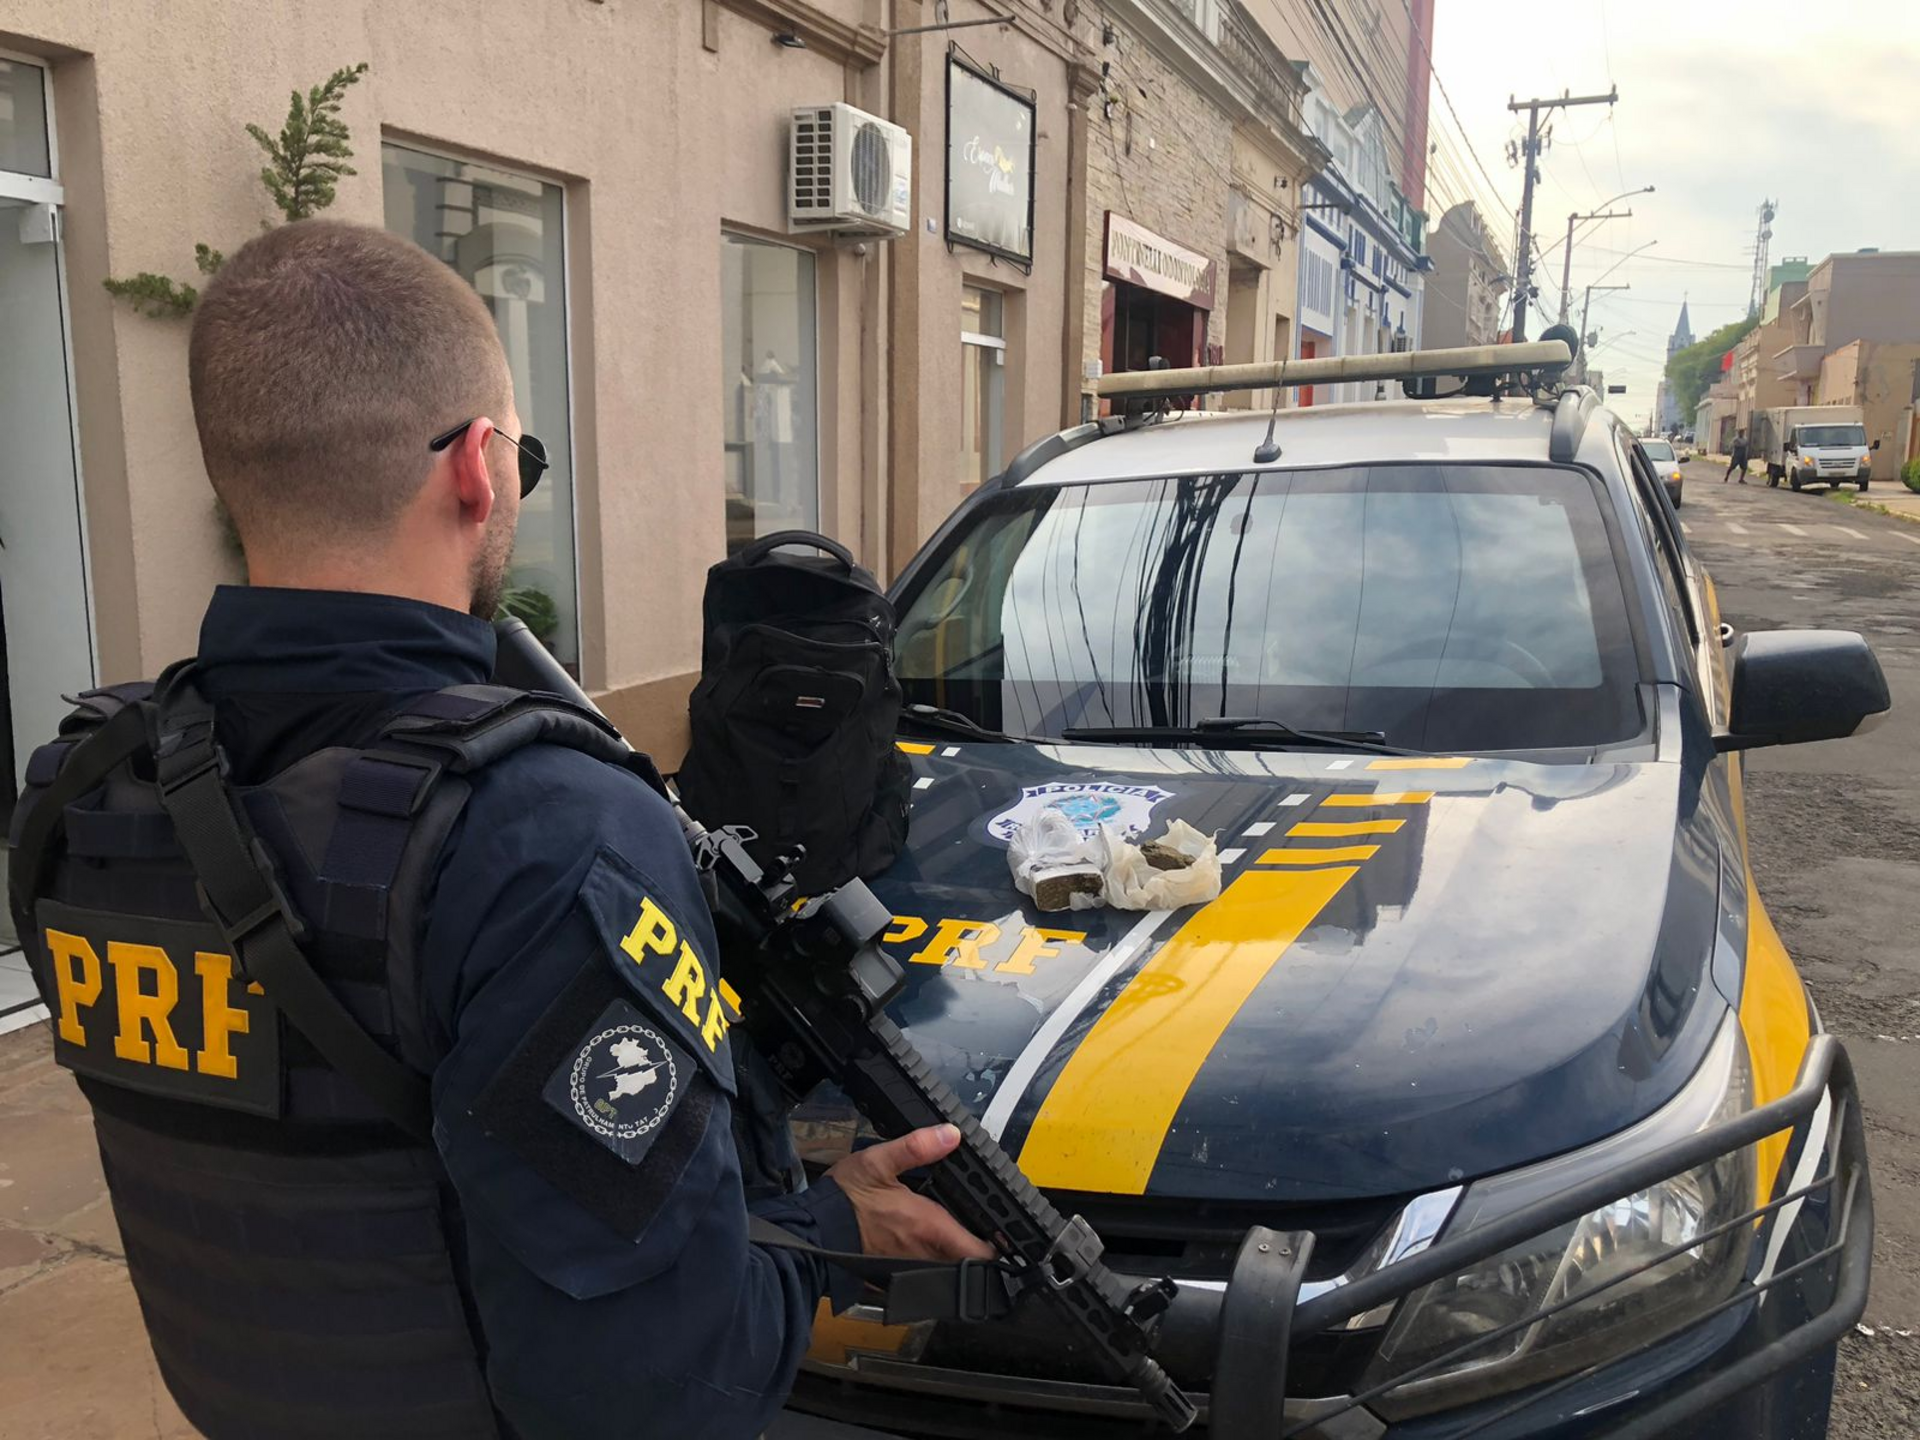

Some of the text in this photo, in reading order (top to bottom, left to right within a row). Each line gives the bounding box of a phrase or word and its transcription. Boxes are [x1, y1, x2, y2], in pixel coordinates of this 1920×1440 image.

[45, 928, 265, 1079] PRF
[620, 896, 730, 1053] PRF
[581, 1096, 634, 1130] PATRULHAMNTO
